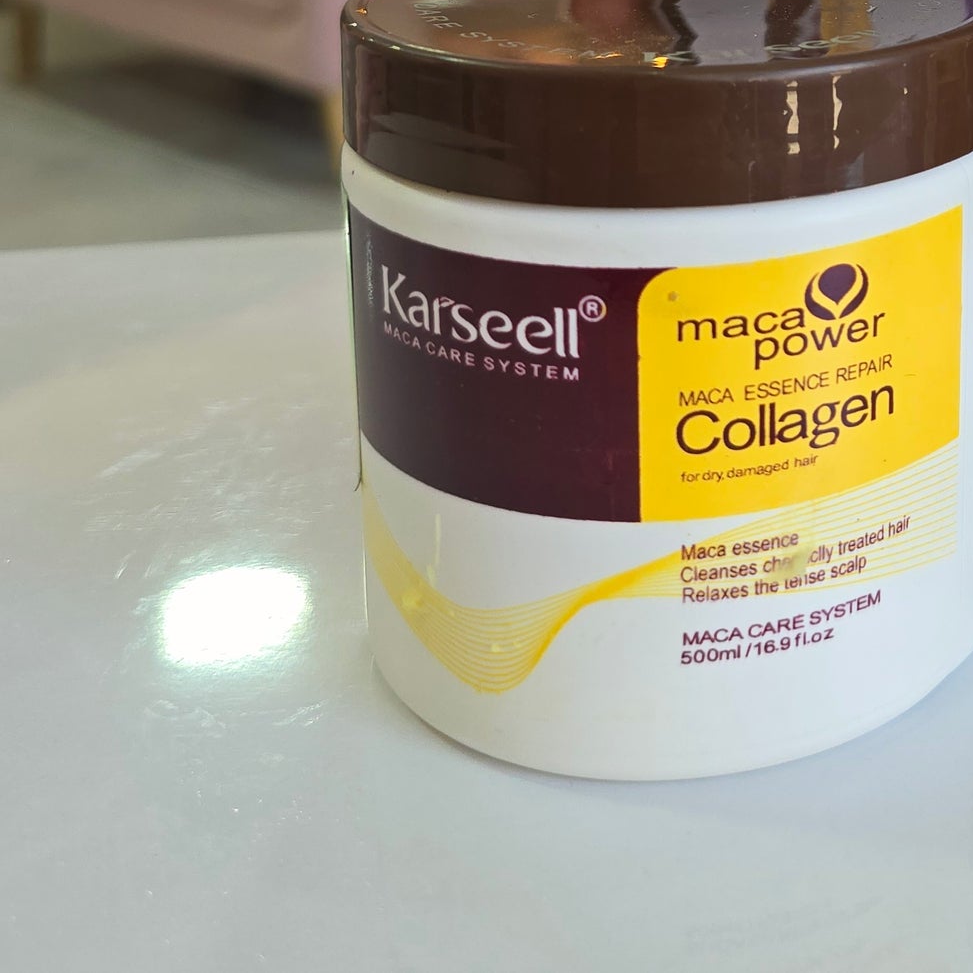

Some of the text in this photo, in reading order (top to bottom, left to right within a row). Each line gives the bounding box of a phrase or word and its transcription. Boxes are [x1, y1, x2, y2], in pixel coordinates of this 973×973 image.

[383, 320, 581, 382] MACA CARE SYSTEM
[676, 307, 806, 342] maca
[754, 312, 886, 371] power
[679, 353, 893, 407] MACA ESSENCE REPAIR
[676, 384, 895, 455] Collagen
[681, 471, 700, 483] for
[727, 459, 790, 480] damaged
[794, 453, 818, 467] hair
[680, 532, 800, 561] Maca essence
[680, 514, 911, 584] Cleanses treated hair
[682, 583, 749, 604] Relaxes
[754, 577, 780, 596] the
[830, 554, 868, 579] scalp
[682, 589, 882, 647] MACA CARE SYSTEM
[680, 645, 742, 665] 500ml
